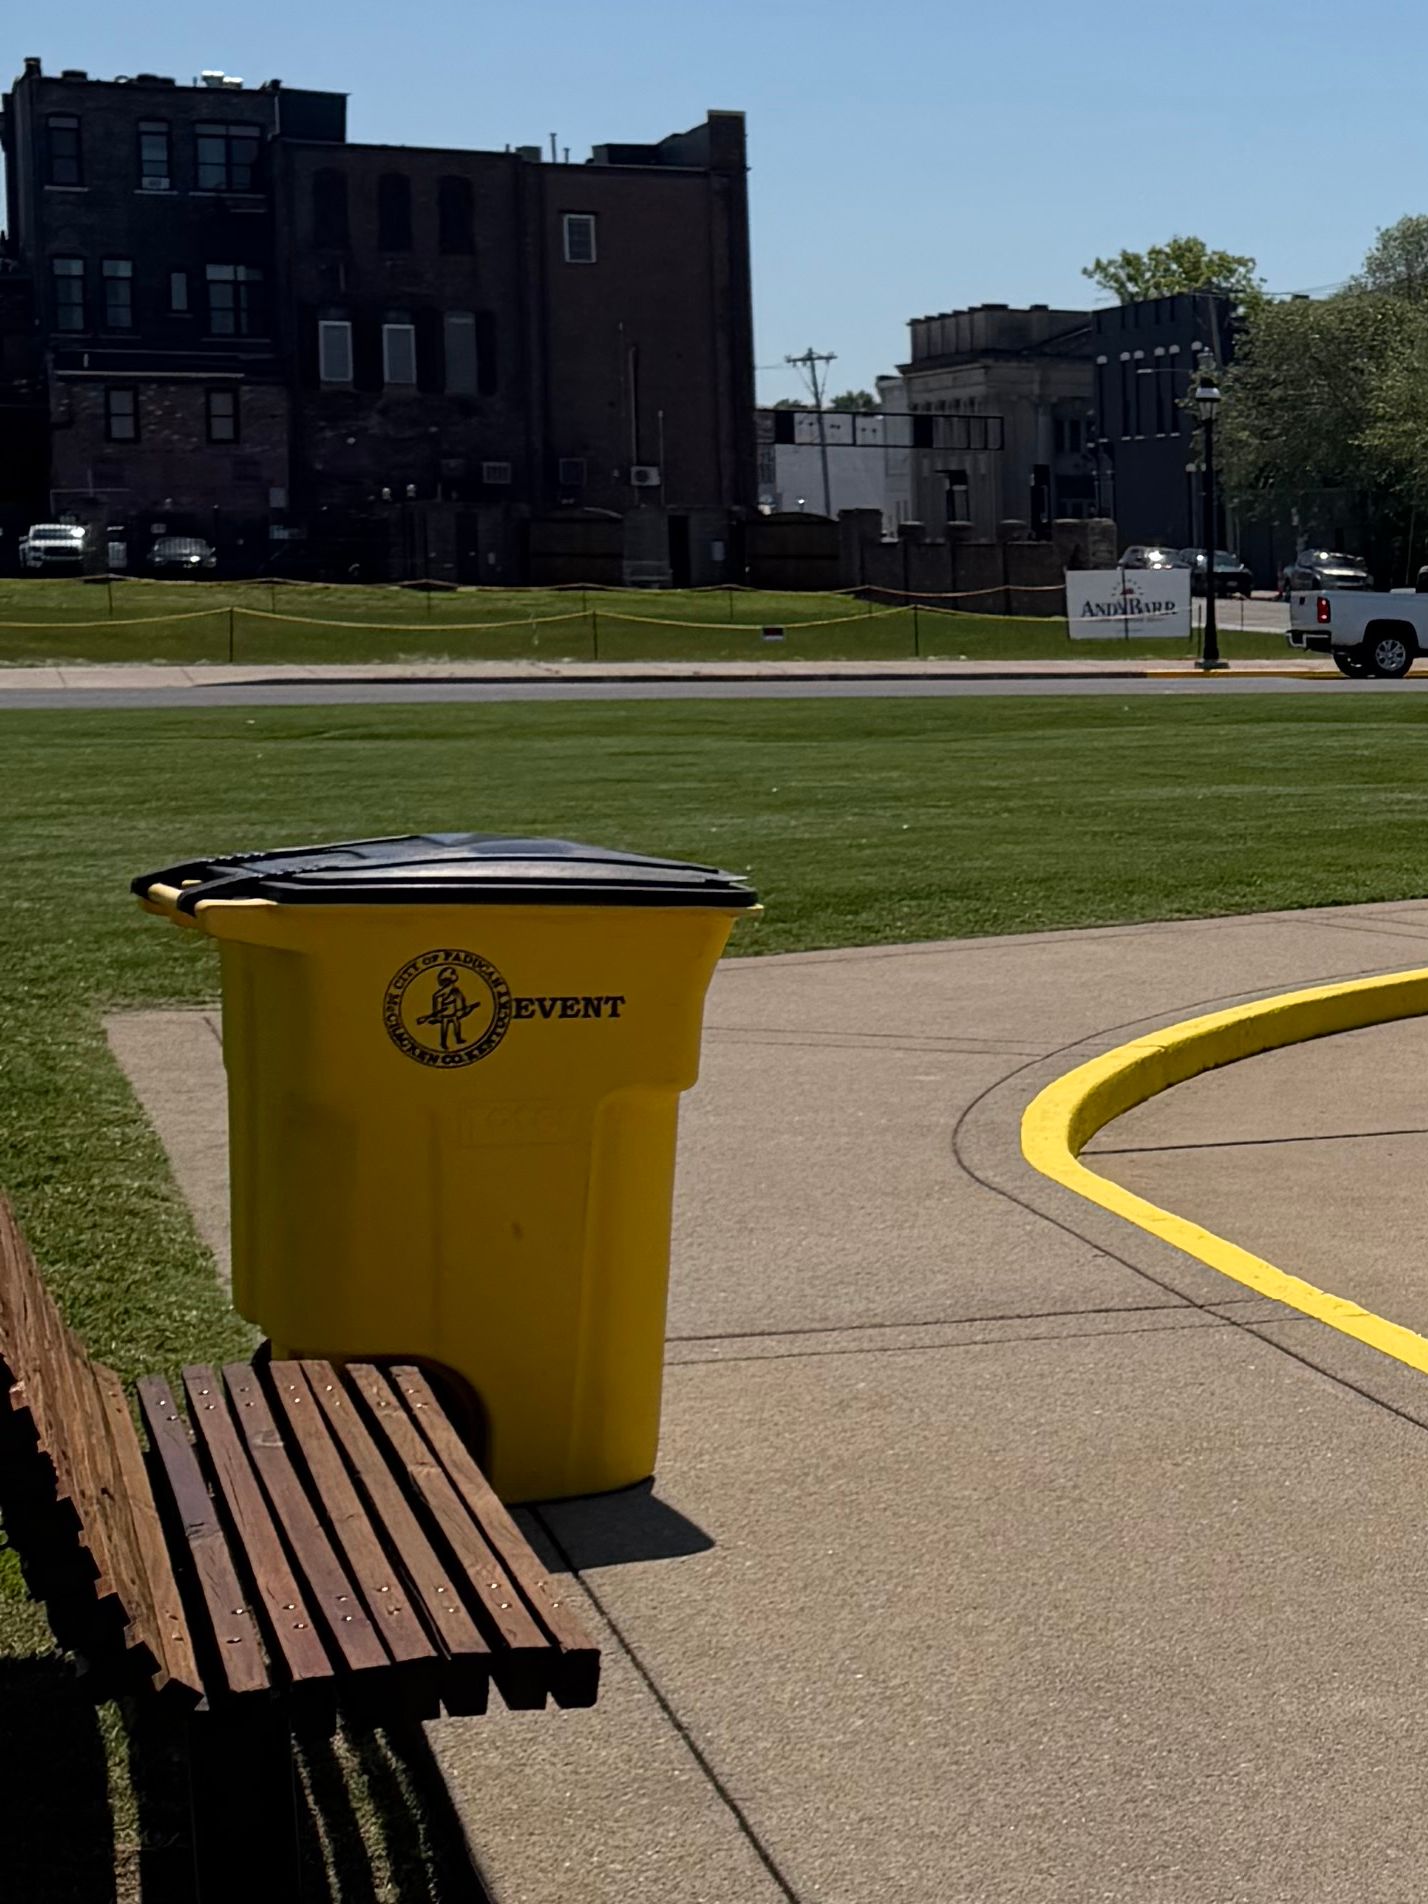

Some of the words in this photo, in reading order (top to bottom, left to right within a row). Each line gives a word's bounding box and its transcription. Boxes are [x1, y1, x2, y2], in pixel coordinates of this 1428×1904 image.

[394, 961, 420, 991] CITY
[422, 954, 440, 966] OF
[513, 996, 626, 1019] EVENT
